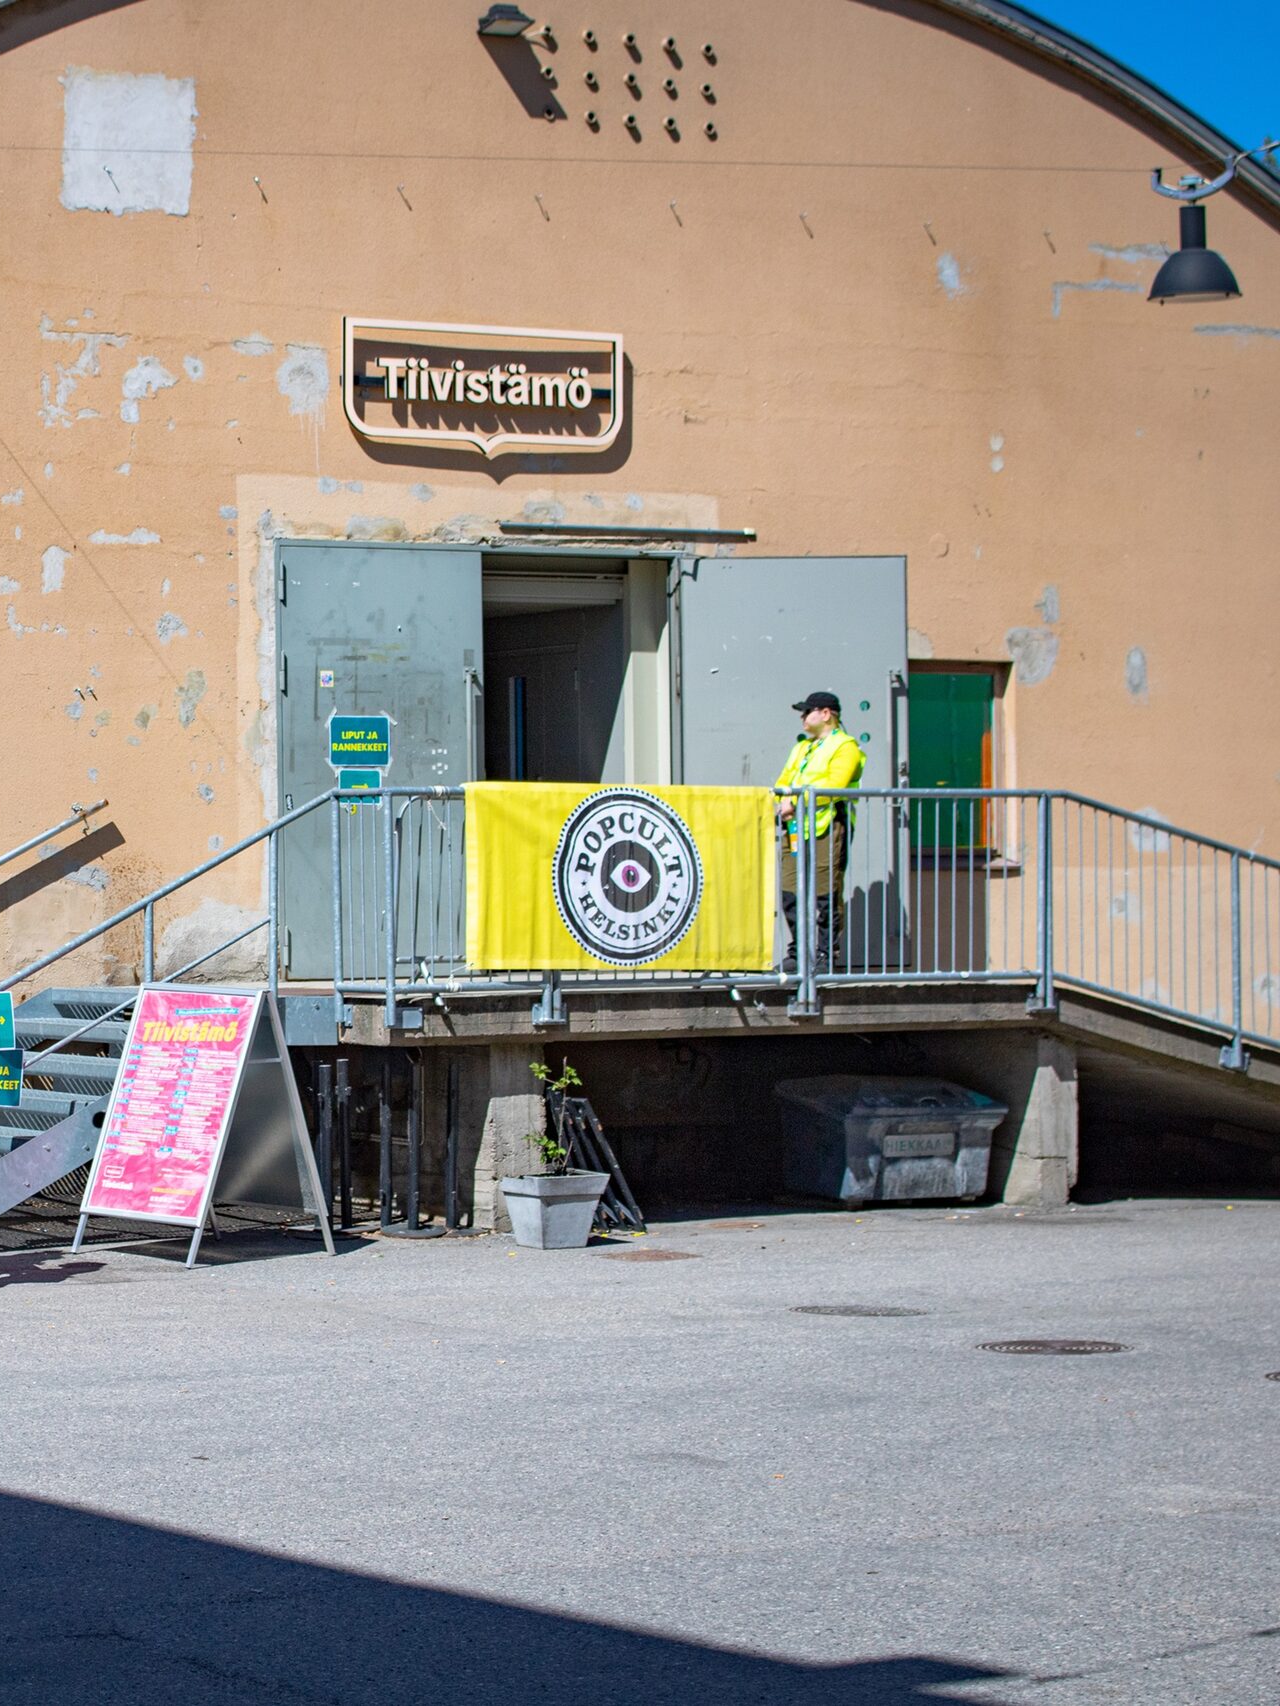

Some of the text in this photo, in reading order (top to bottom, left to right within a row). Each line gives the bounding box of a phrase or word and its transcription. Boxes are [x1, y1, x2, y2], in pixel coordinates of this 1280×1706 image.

[375, 356, 593, 410] Tiivistämö
[332, 742, 387, 752] RANNEKKEET
[341, 730, 378, 740] LIPUT JA
[575, 812, 683, 879] POPCULT
[578, 890, 681, 941] HELSINKI
[141, 1020, 239, 1043] Tiivistämö
